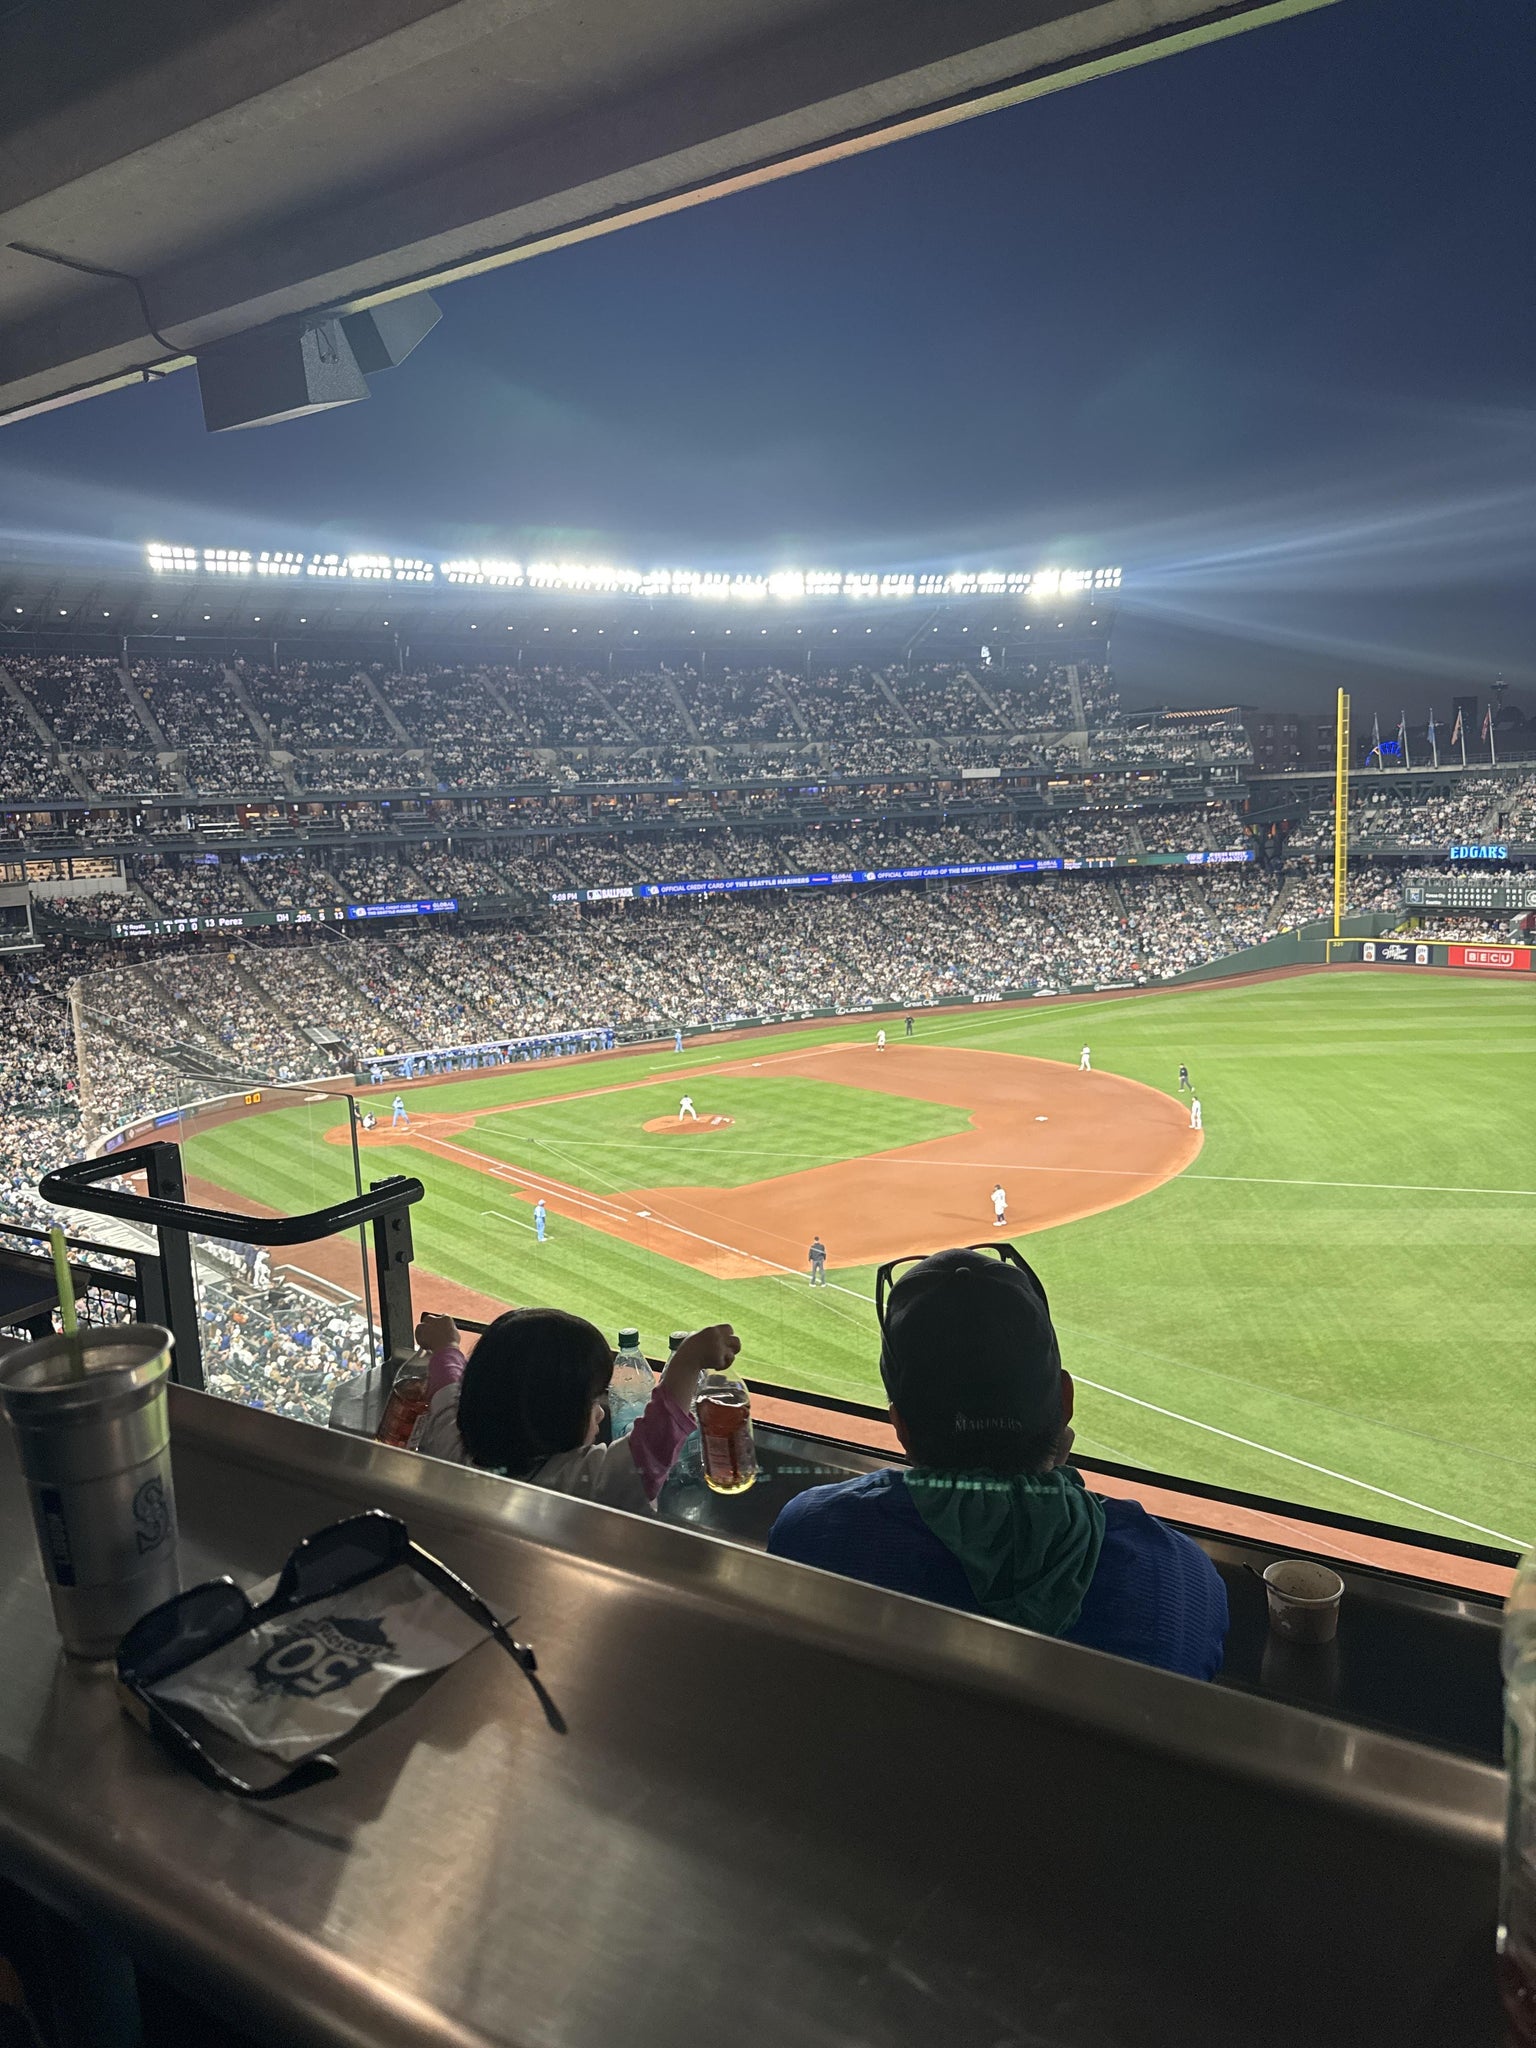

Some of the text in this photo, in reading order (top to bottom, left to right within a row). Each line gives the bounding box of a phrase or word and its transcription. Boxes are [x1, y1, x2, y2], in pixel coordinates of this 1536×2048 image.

[1450, 846, 1507, 859] EDGARS
[987, 864, 1016, 872] MARINERS
[708, 881, 724, 890] CARD
[749, 879, 776, 887] SEATTLE
[778, 877, 809, 885] MARINERS
[602, 887, 633, 898] BALLPARK
[205, 919, 215, 928] 13
[219, 918, 243, 926] Perez
[276, 914, 289, 922] DH
[295, 915, 312, 923] .205
[334, 911, 344, 920] 13
[1468, 952, 1511, 963] BECU
[903, 1000, 922, 1008] Great
[972, 994, 1002, 1003] STIHL
[846, 1006, 873, 1014] LEXUS
[955, 1418, 1023, 1432] MARINERS
